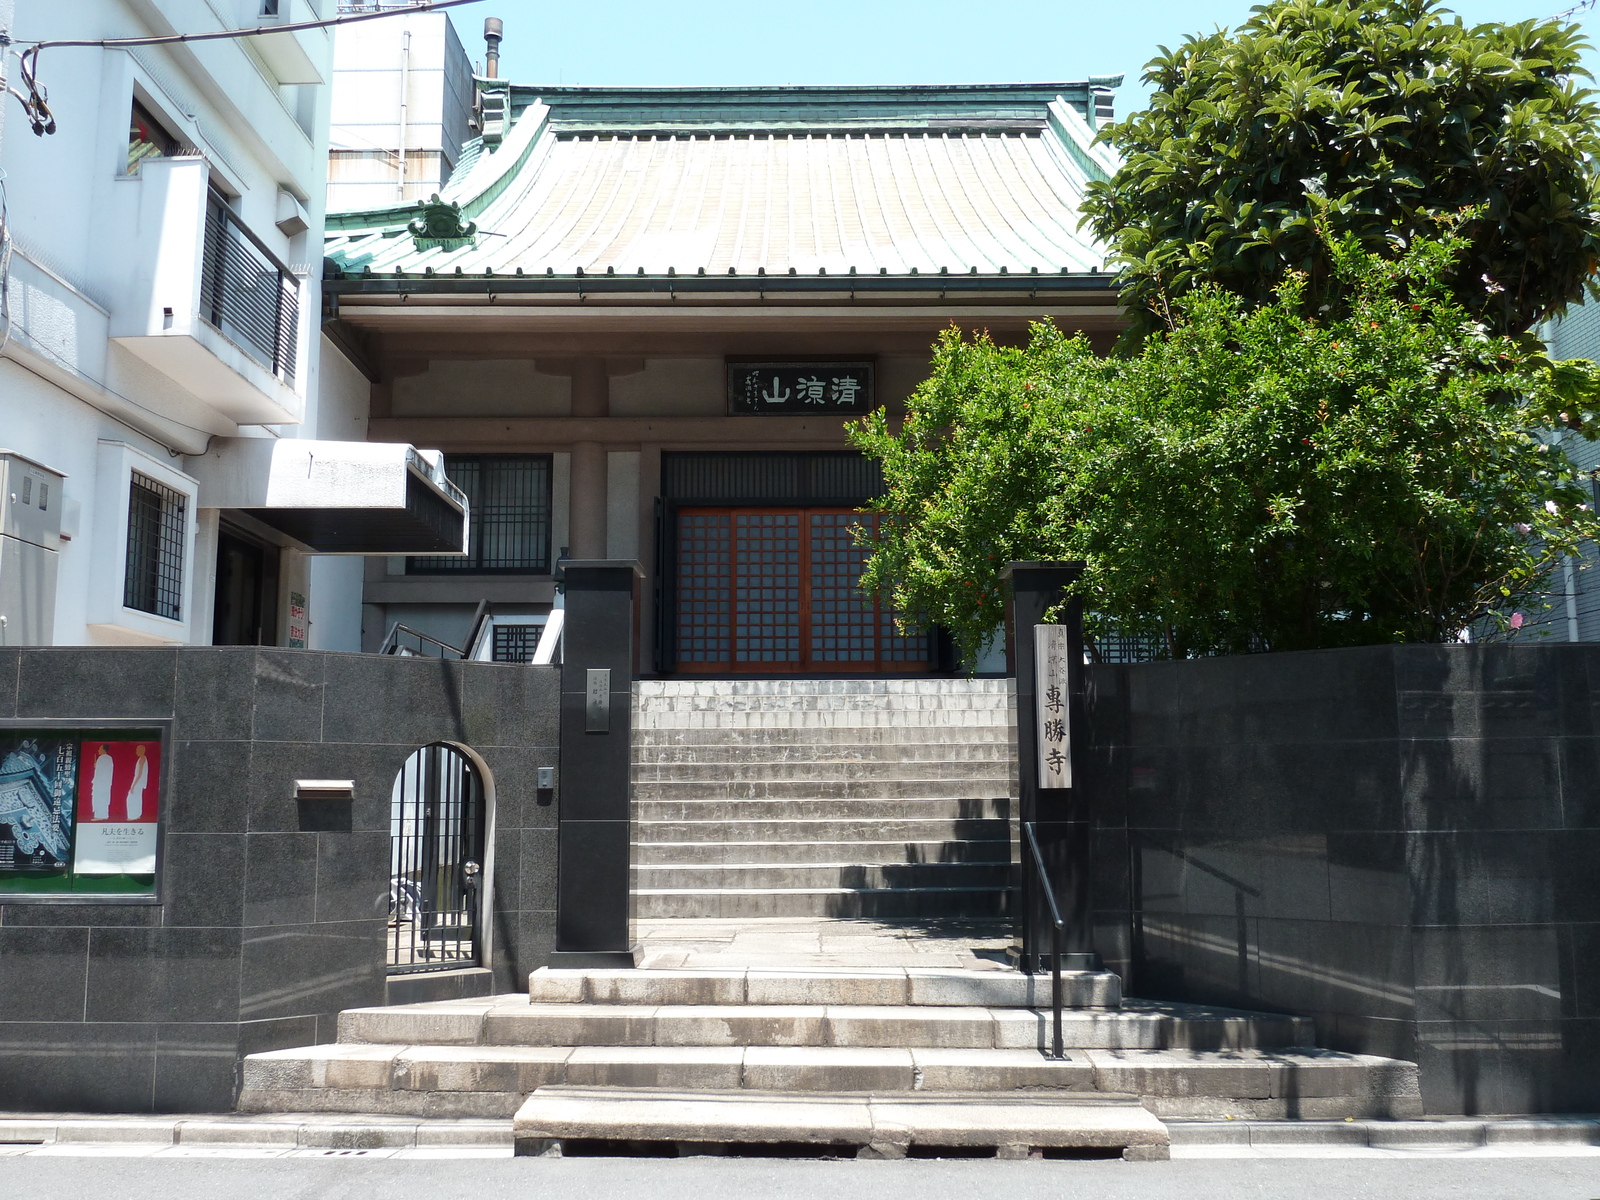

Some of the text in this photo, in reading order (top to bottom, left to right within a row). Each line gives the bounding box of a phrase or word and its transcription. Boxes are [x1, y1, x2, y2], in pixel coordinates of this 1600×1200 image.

[101, 827, 144, 836] 凡夫を生きる
